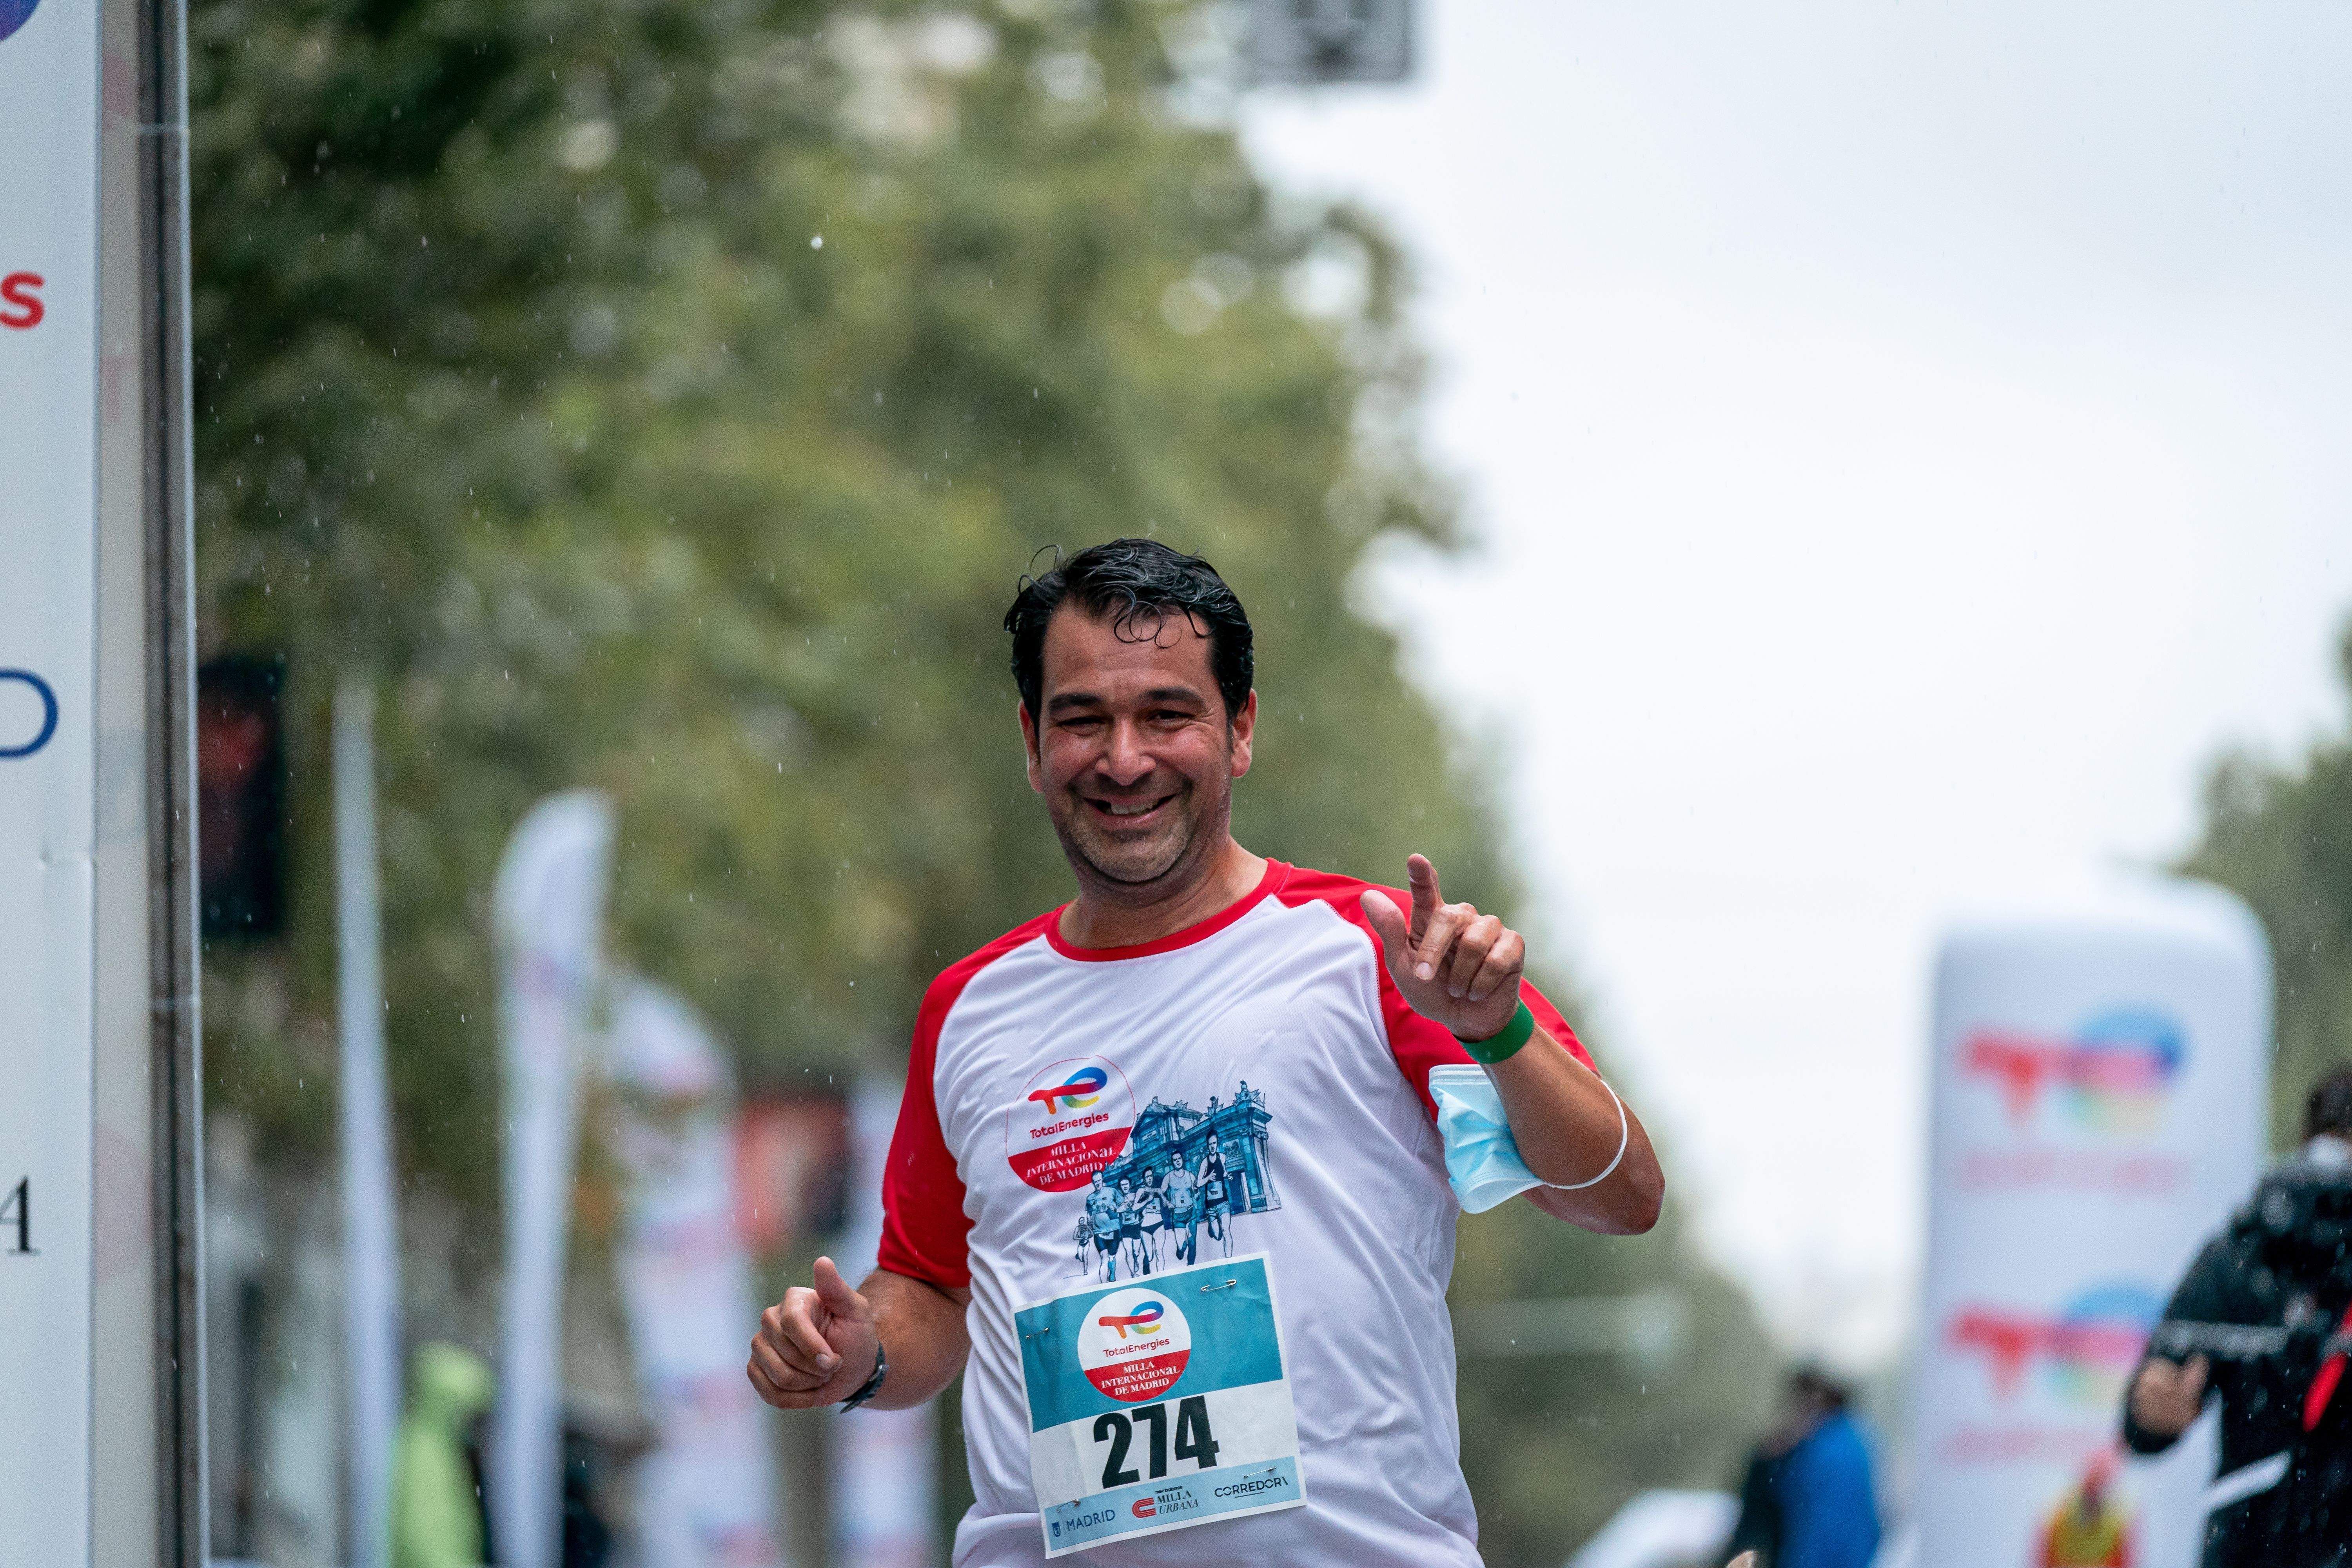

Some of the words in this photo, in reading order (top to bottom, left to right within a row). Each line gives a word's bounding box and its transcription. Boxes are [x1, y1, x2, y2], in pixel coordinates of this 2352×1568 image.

[1030, 1113, 1109, 1139] TotalEnergies
[1051, 1142, 1087, 1156] MILLA
[1039, 1173, 1055, 1185] DE
[1056, 1161, 1103, 1179] MADRID
[1103, 1338, 1170, 1357] TotalEnergies
[1123, 1361, 1155, 1374] MILLA
[1114, 1386, 1129, 1396] DE
[1131, 1377, 1170, 1392] MADRID
[1093, 1395, 1220, 1490] 274
[1157, 1490, 1192, 1504] MILLA
[1160, 1498, 1199, 1514] URBANA
[1066, 1509, 1116, 1532] MADRID
